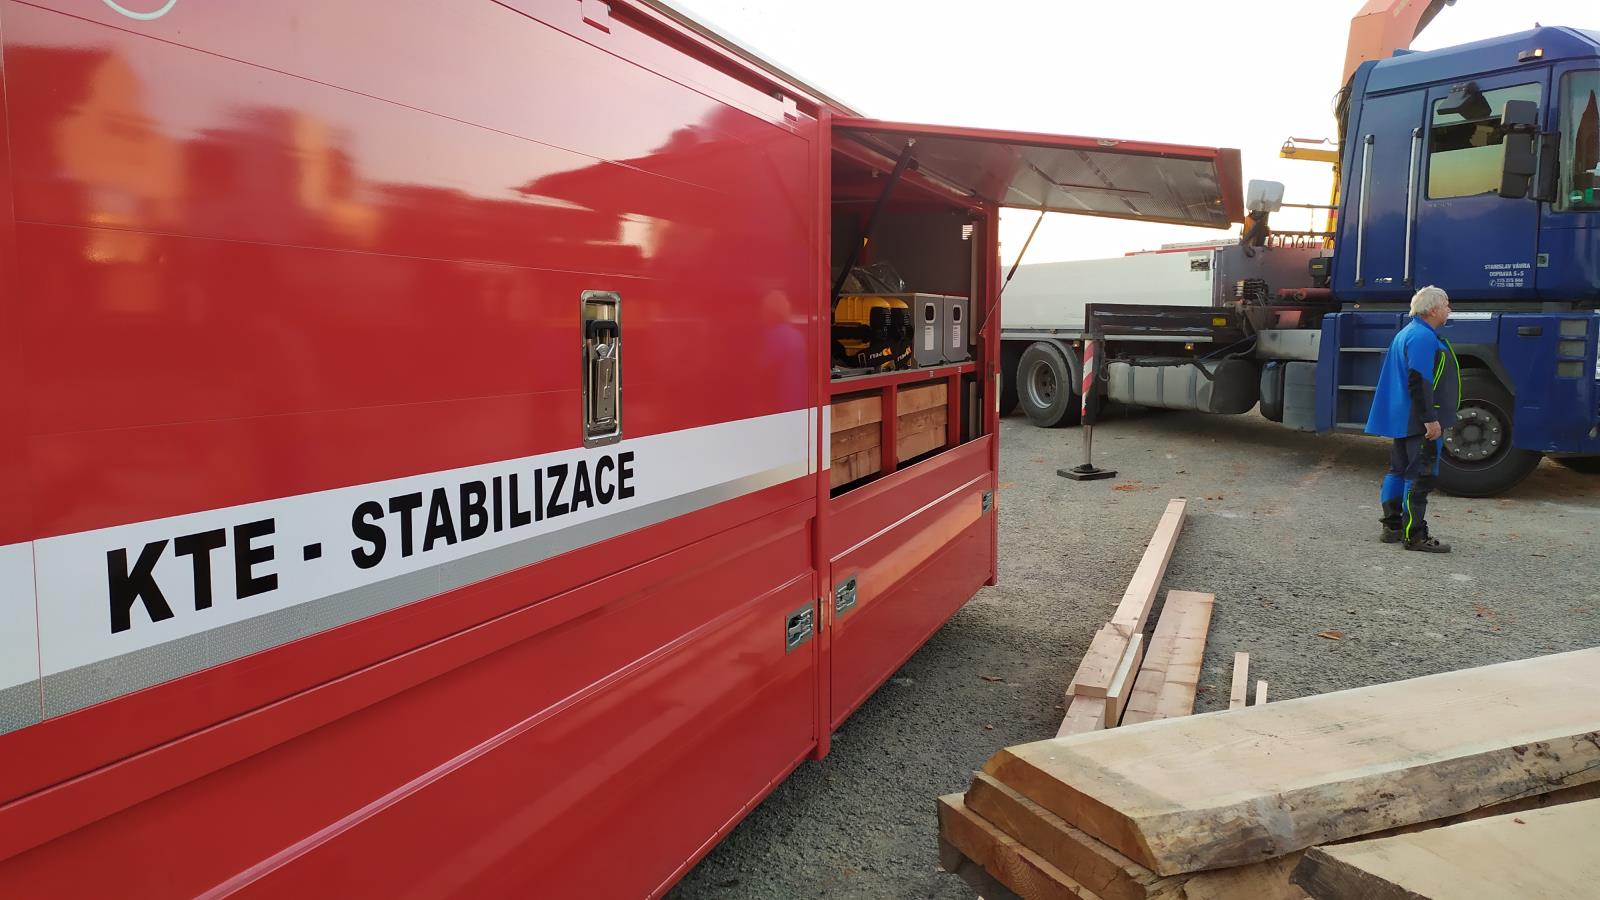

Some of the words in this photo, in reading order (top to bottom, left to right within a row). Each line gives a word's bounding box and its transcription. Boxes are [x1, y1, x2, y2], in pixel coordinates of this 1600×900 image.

[107, 518, 278, 634] KTE
[303, 542, 322, 561] -
[351, 451, 635, 570] STABILIZACE
